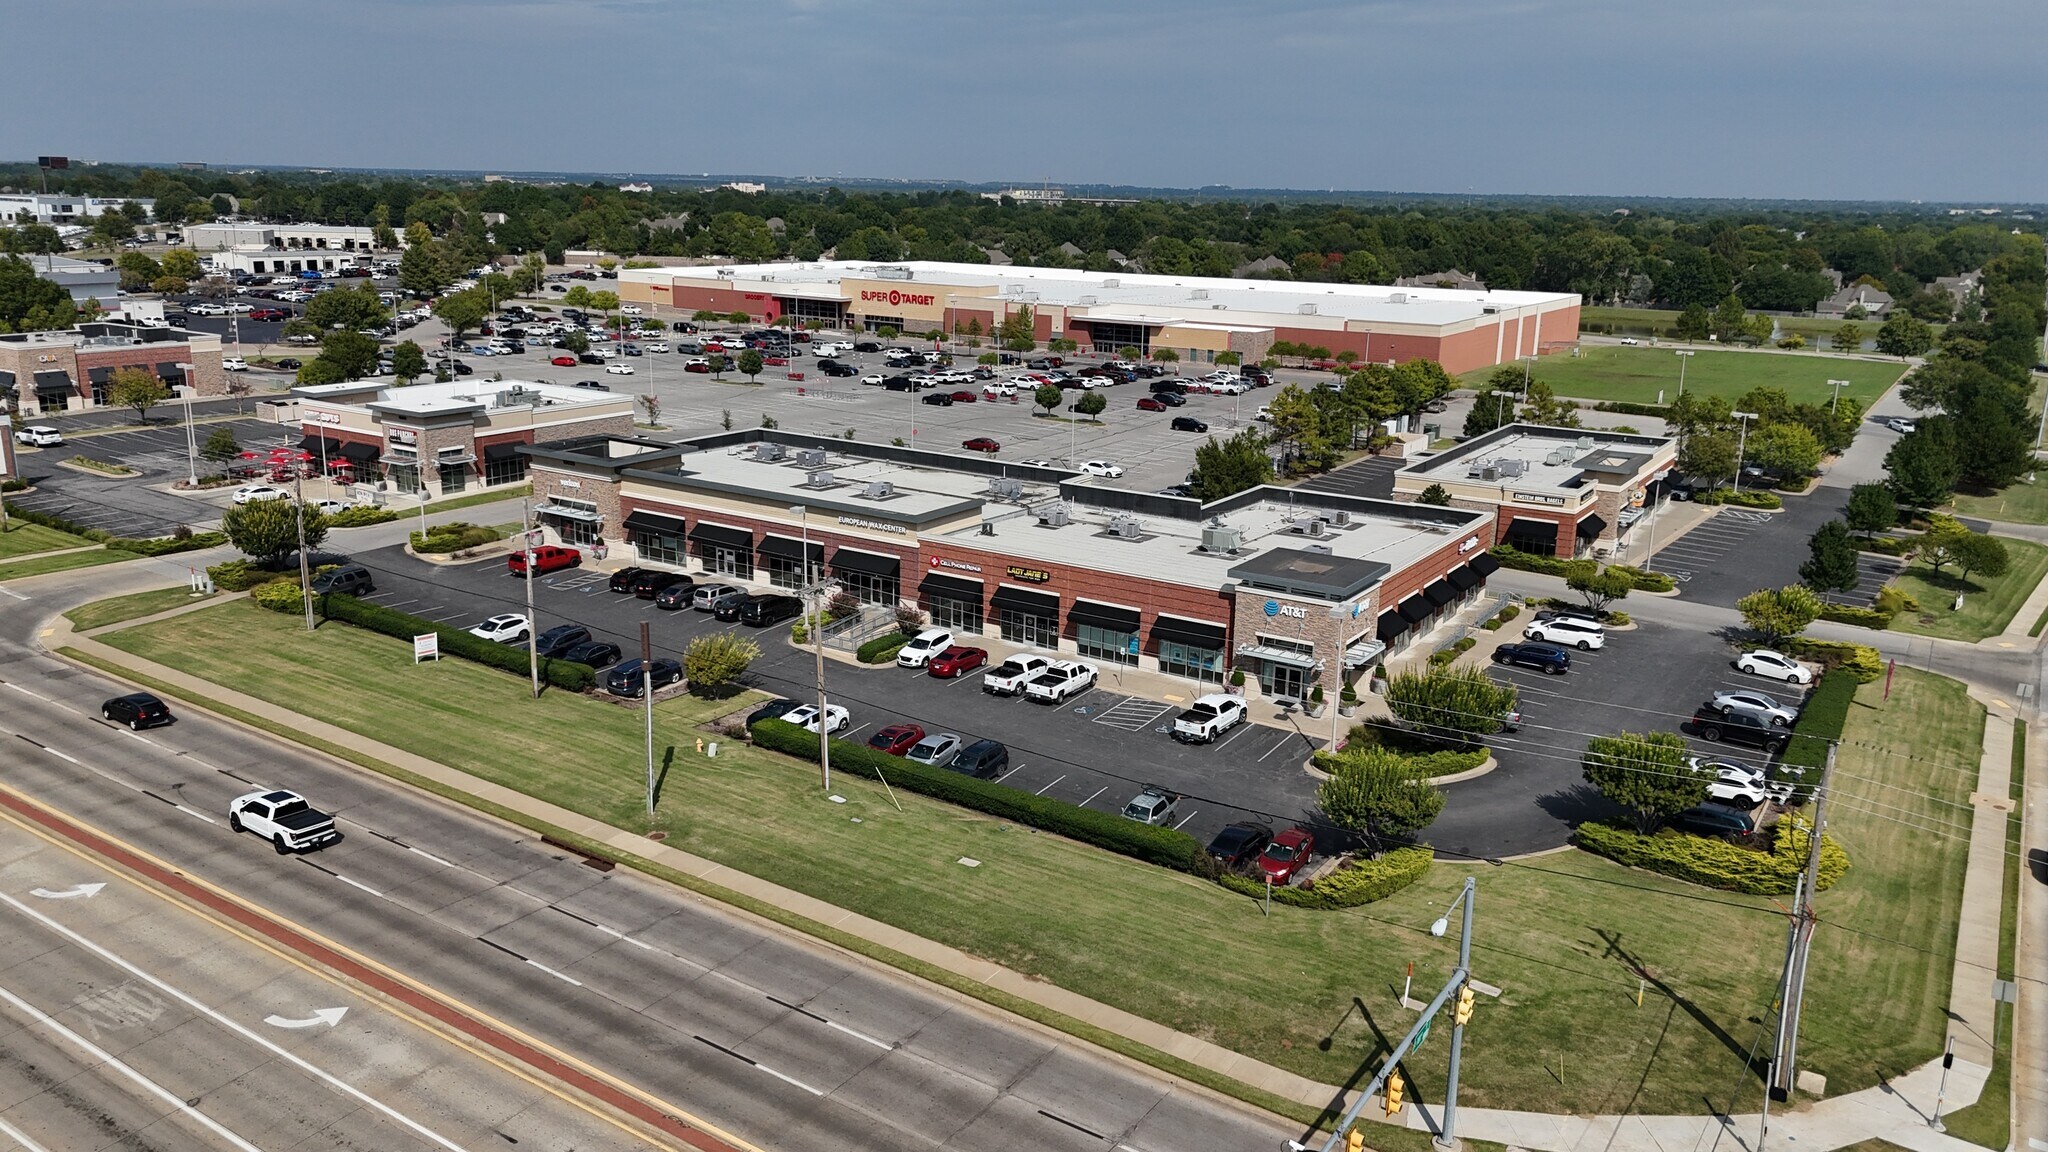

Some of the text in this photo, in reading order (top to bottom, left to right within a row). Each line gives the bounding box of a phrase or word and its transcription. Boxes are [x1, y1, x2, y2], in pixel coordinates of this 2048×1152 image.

[861, 290, 935, 306] SUPER TARGET
[838, 516, 906, 533] EUROPEAN WAX CENTER
[1007, 566, 1025, 576] LADY
[1280, 605, 1307, 619] AT&T
